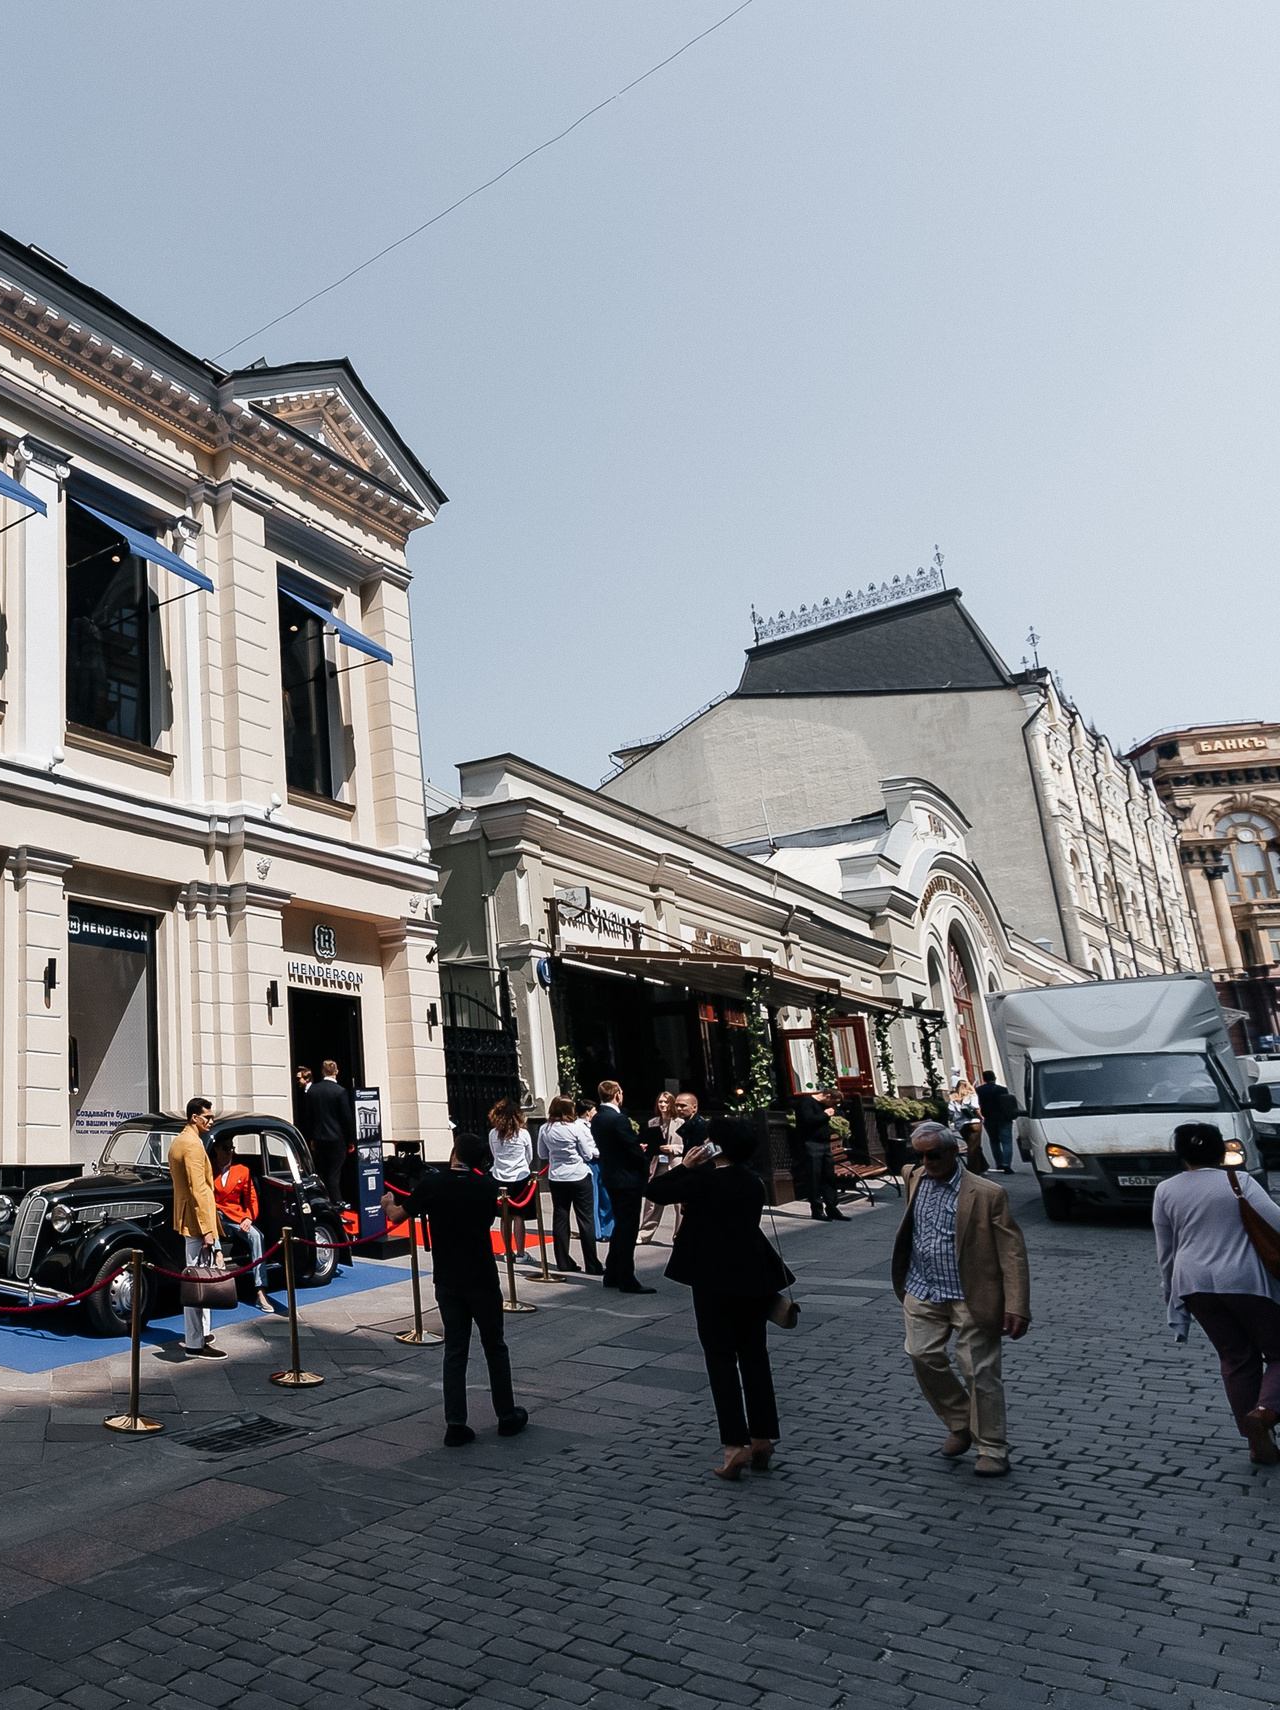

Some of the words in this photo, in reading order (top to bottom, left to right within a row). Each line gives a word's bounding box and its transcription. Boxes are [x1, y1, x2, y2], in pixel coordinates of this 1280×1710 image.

[1200, 737, 1266, 752] БАНКЪ
[82, 921, 148, 941] HENDERSON
[291, 961, 364, 984] HENDERSON
[75, 1108, 115, 1118] Создавайте
